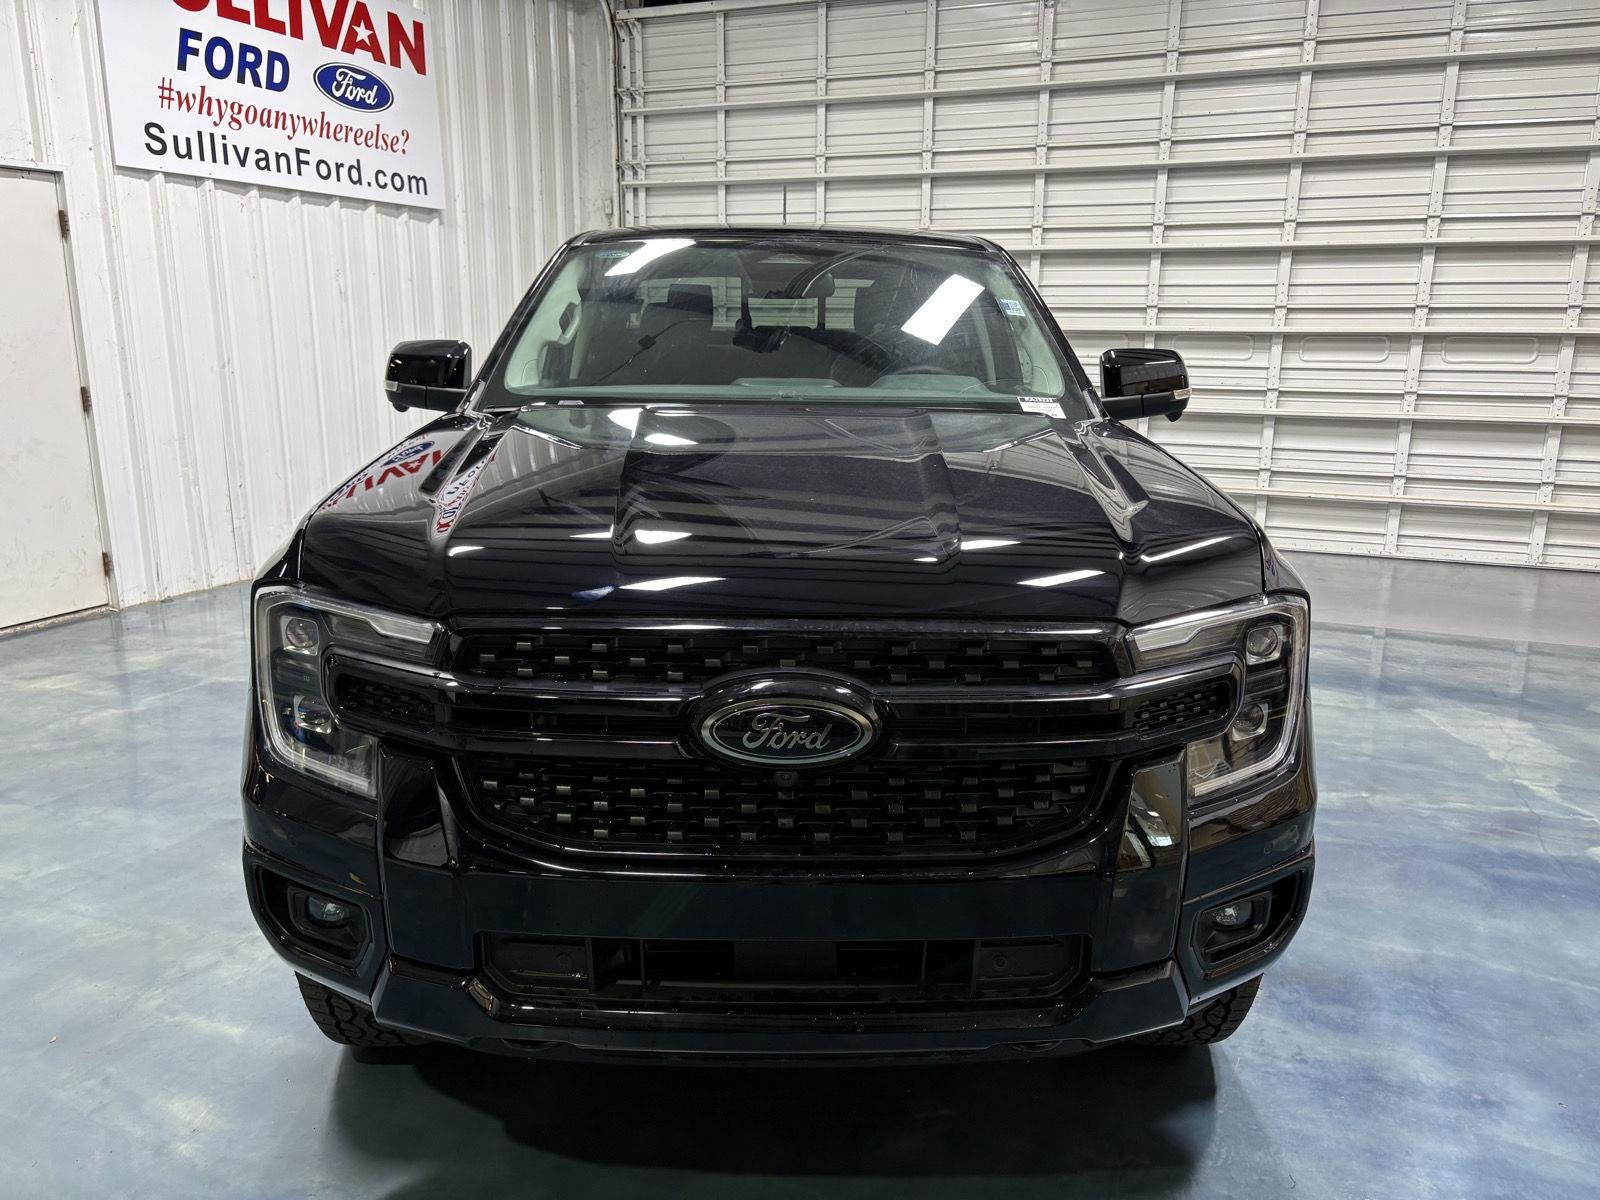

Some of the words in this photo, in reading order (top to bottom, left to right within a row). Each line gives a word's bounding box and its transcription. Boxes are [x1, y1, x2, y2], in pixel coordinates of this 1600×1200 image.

[175, 0, 426, 75] LIVAN
[177, 27, 290, 92] FORD
[158, 77, 410, 155] #whygoanywhereelse?
[331, 68, 379, 106] Ford
[144, 122, 428, 196] SullivanFord.com
[742, 711, 833, 750] Ford
